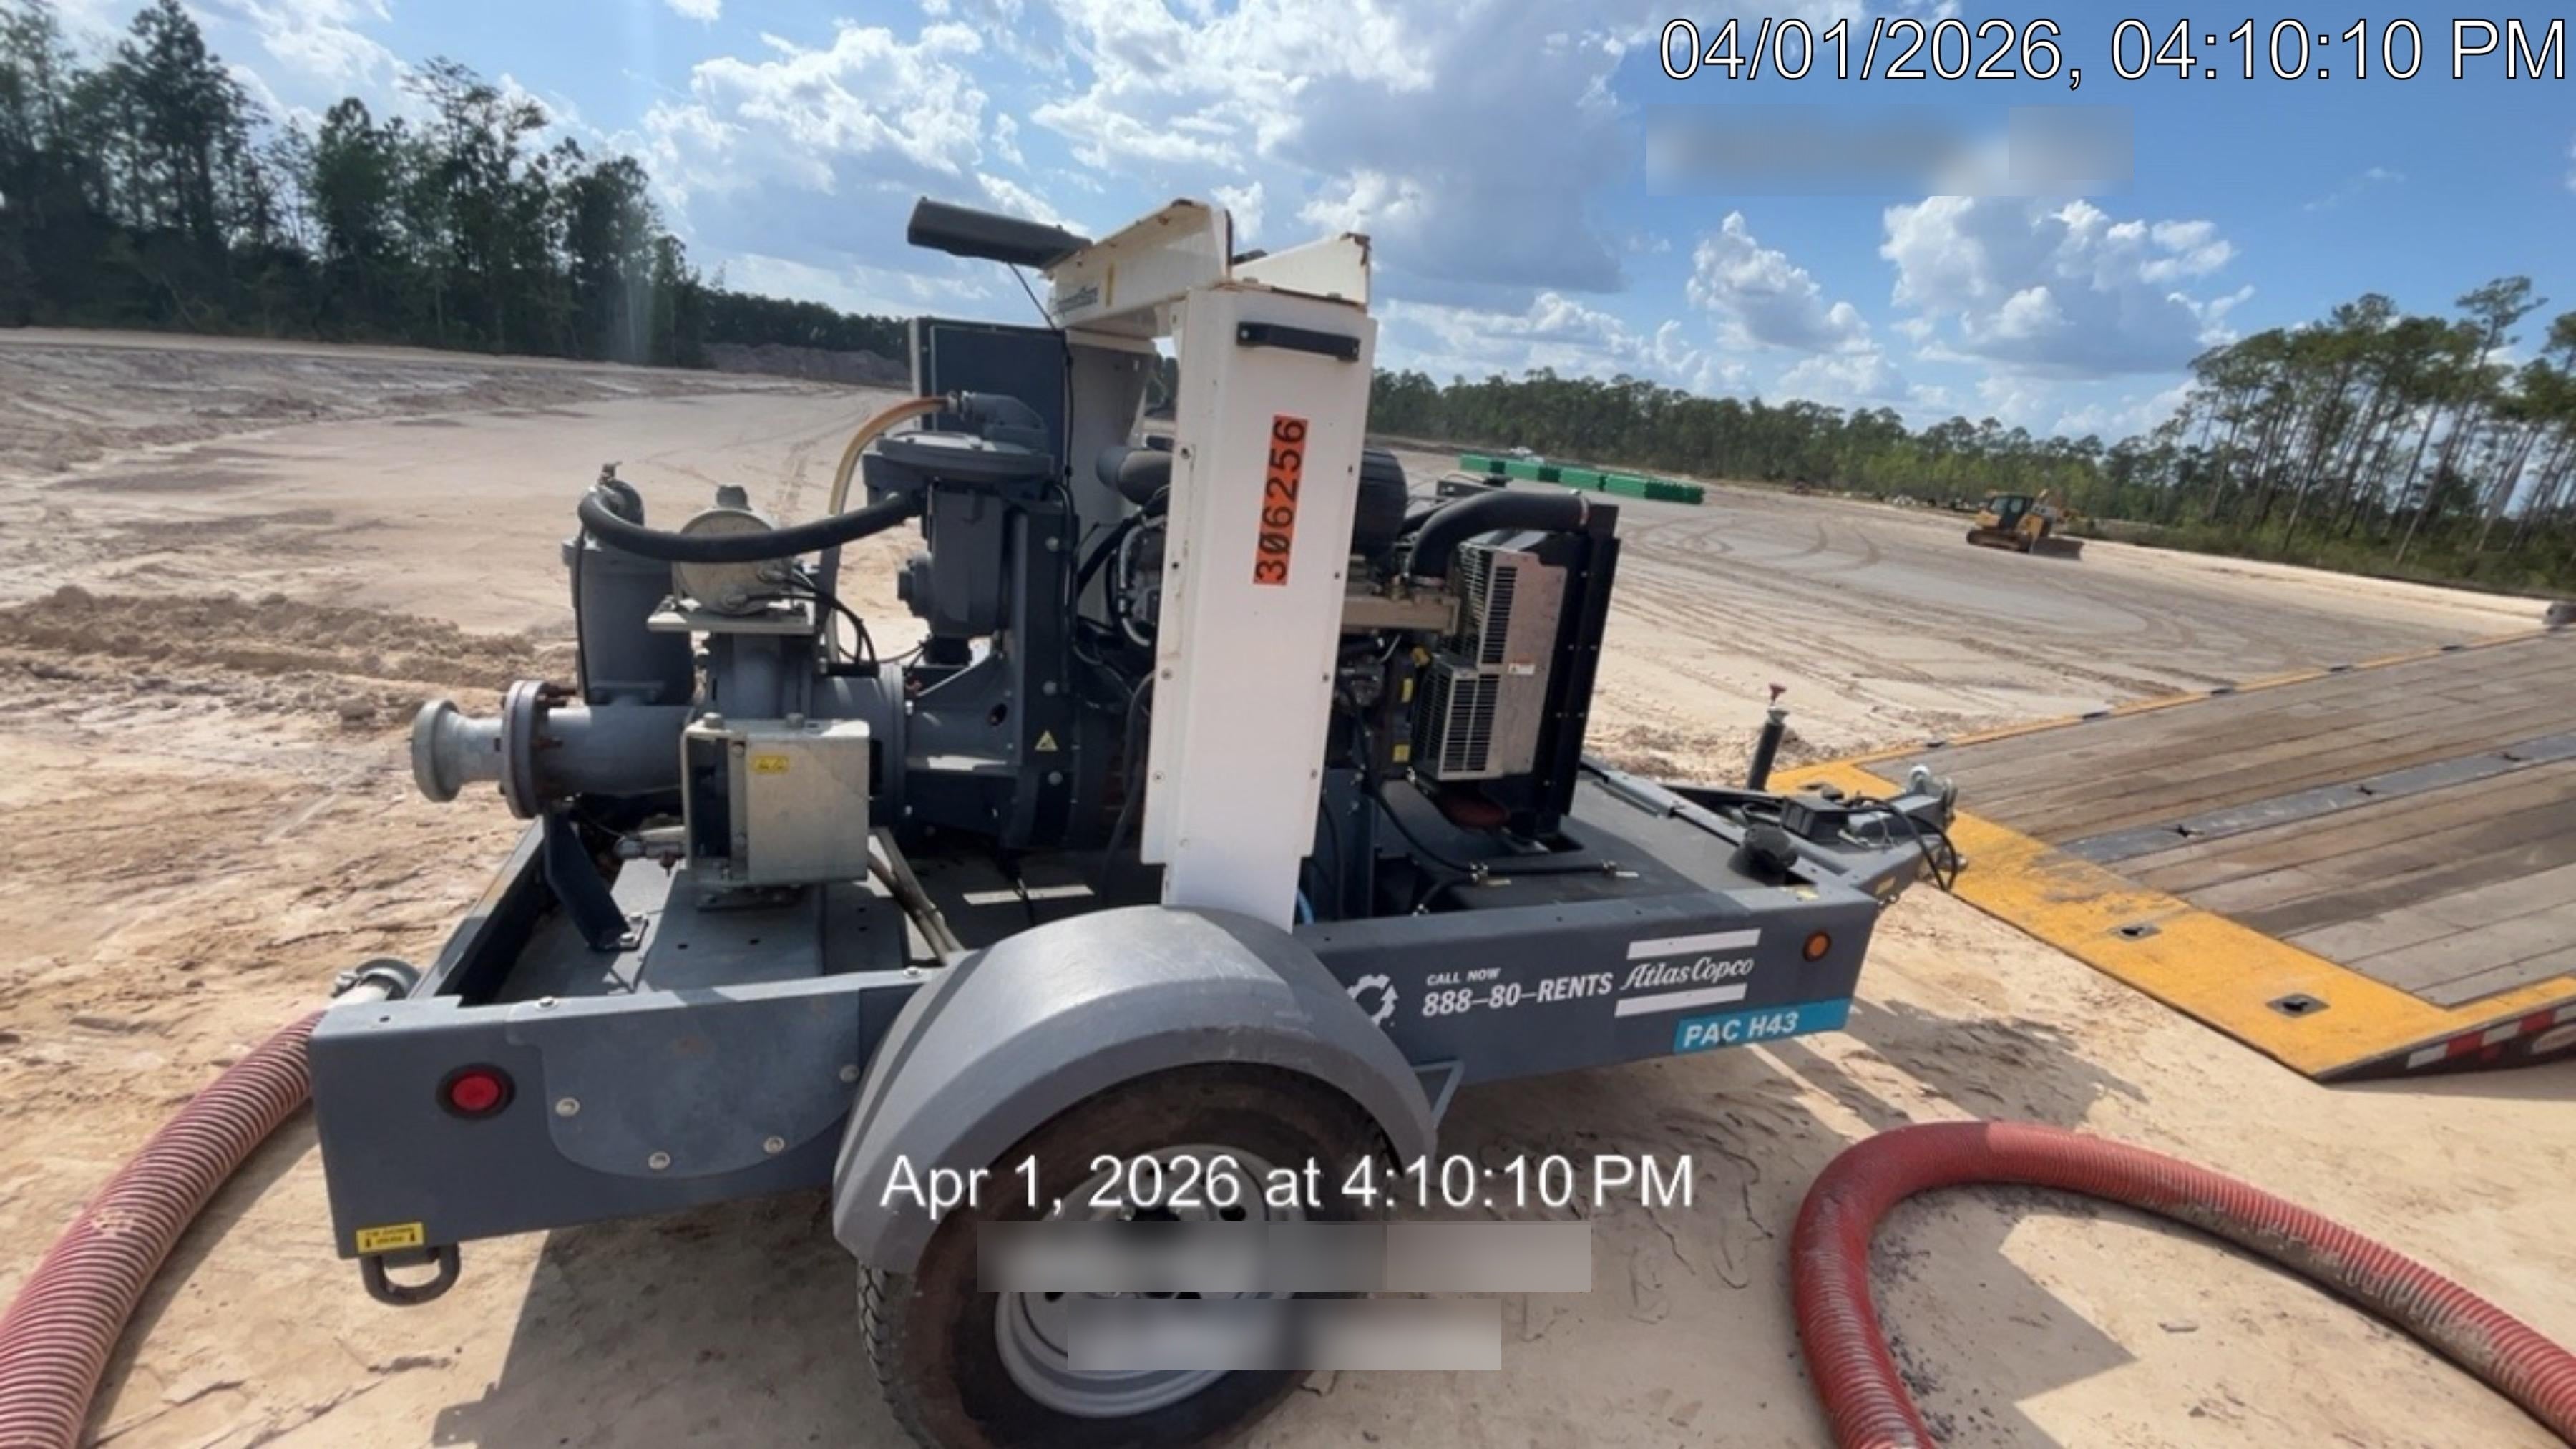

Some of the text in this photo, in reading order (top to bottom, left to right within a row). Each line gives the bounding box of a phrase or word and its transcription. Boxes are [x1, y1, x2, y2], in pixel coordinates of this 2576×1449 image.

[1255, 419, 1306, 582] 306256
[1426, 967, 1501, 986] CALL NOW
[1684, 1012, 1800, 1048] PAC H43
